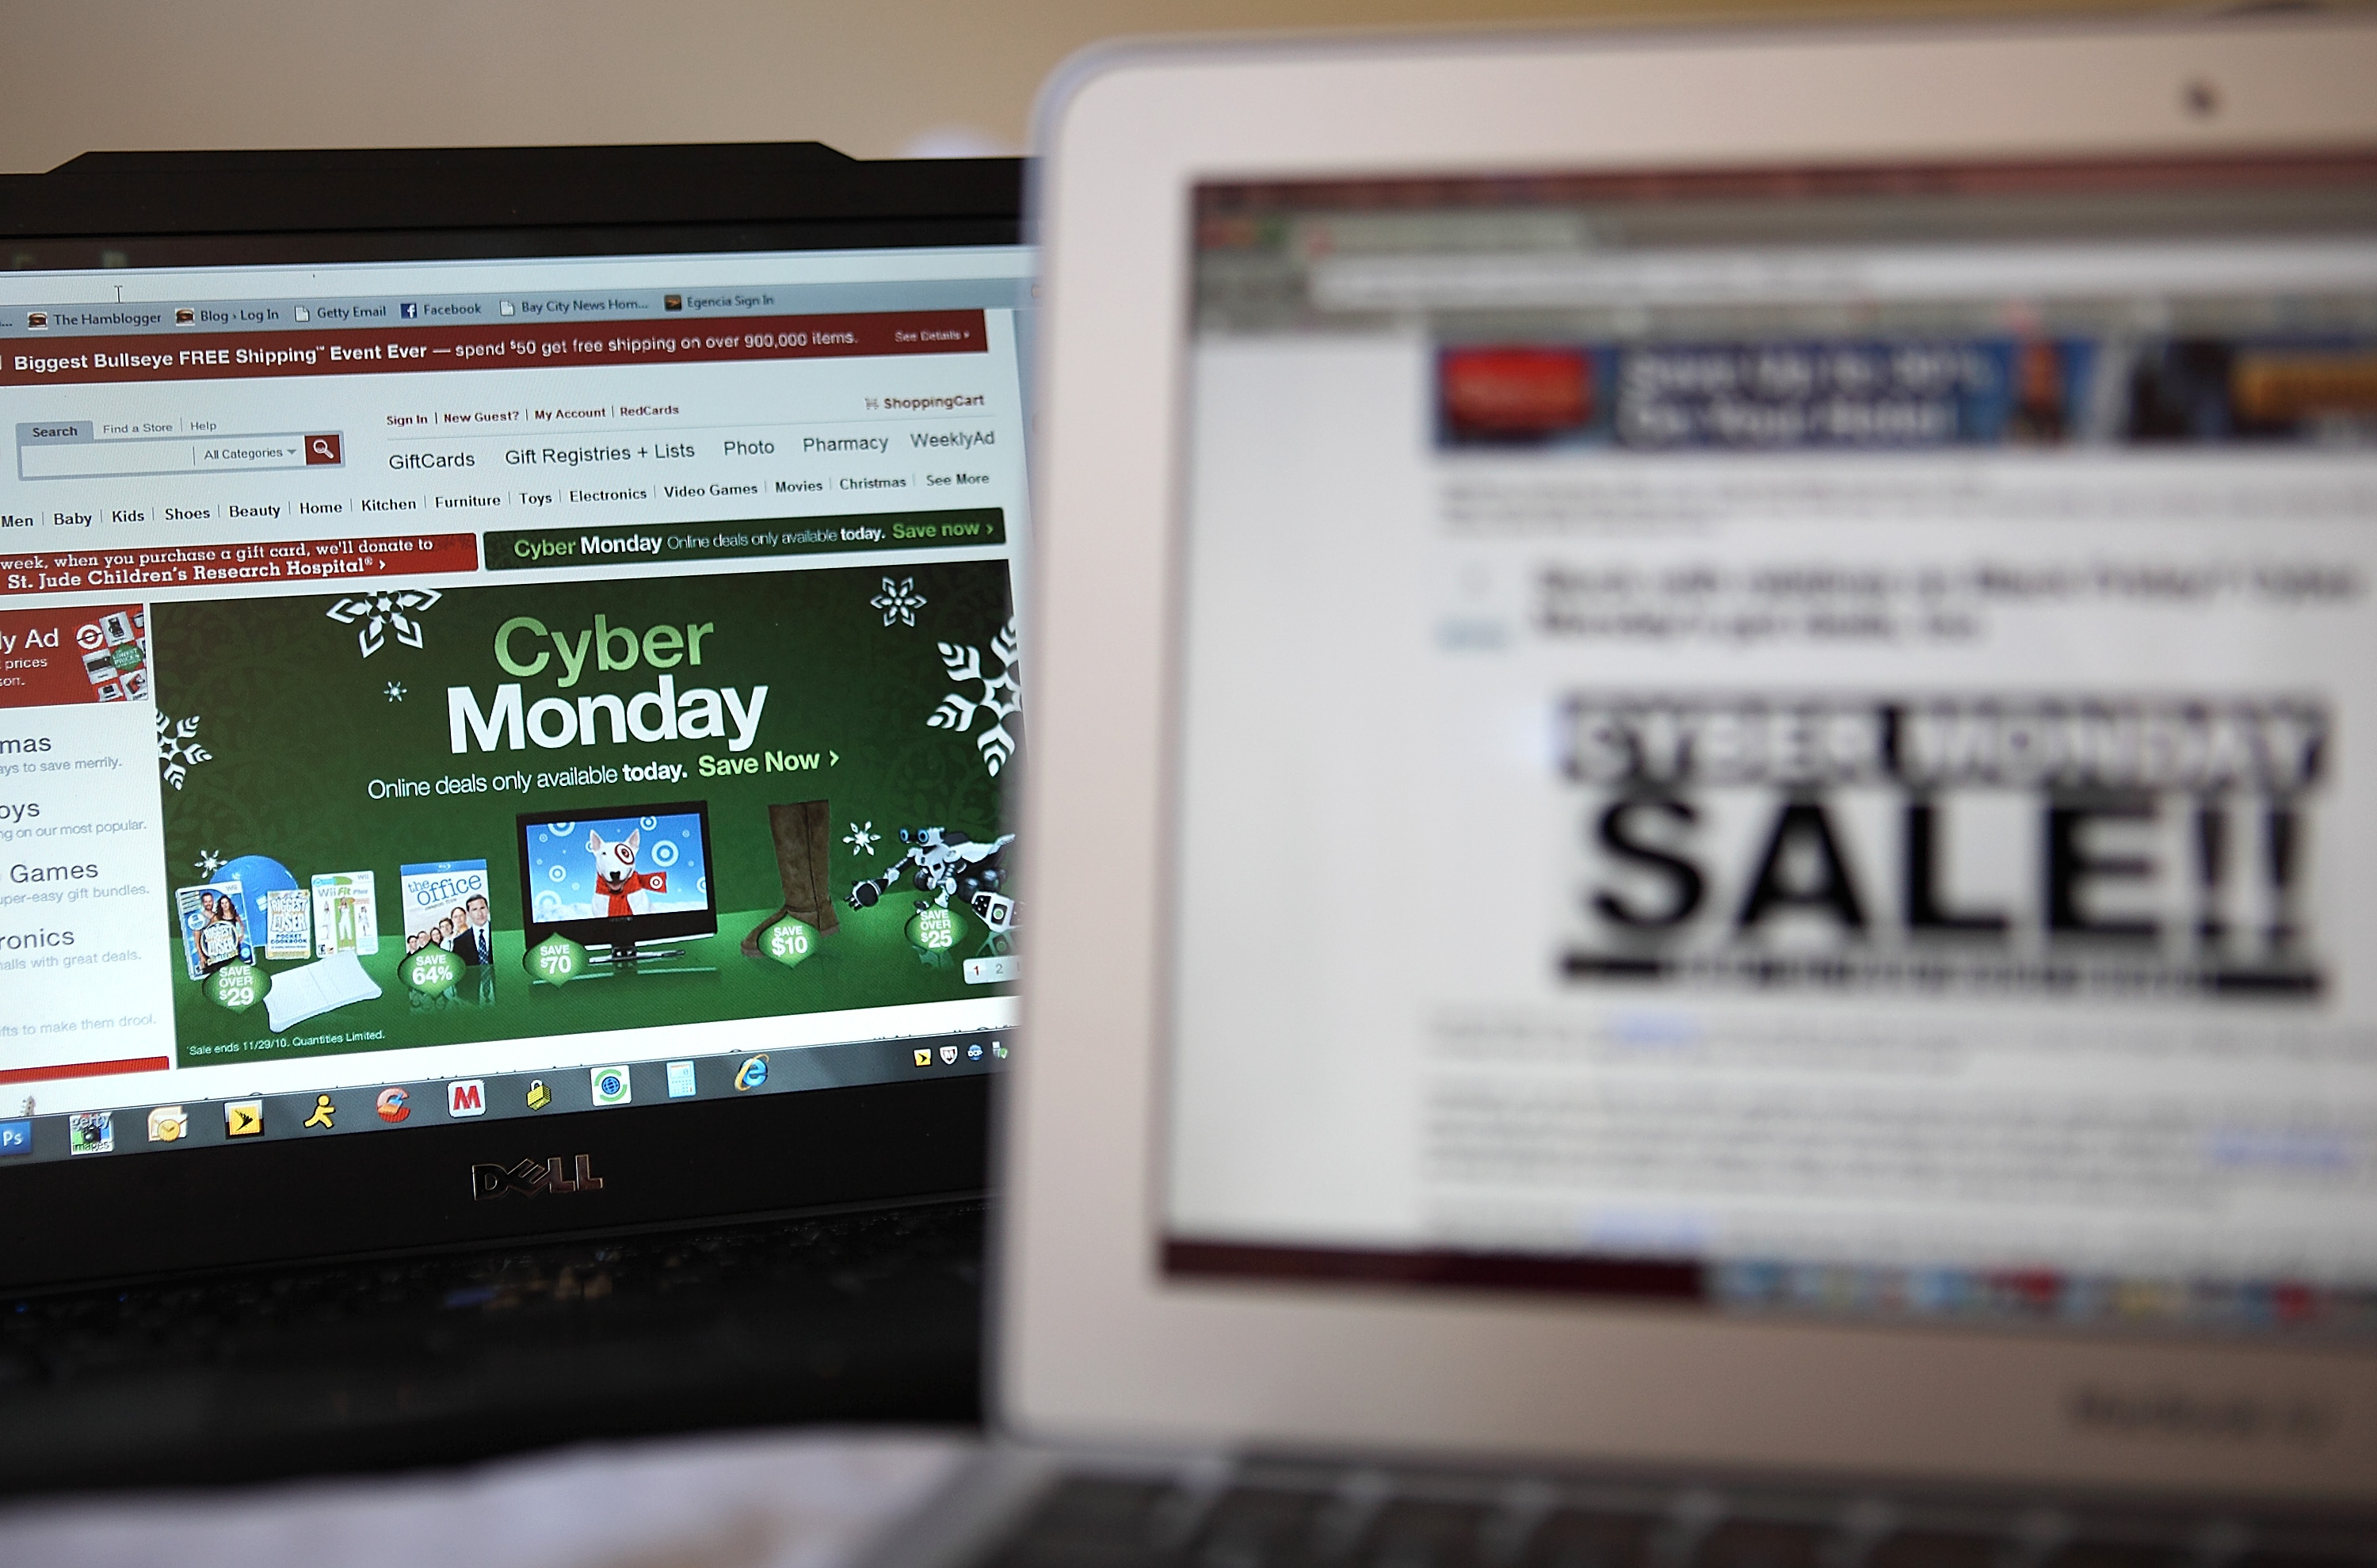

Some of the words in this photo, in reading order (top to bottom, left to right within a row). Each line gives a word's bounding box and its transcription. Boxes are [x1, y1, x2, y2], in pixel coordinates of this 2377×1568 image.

[423, 303, 482, 315] Facebook
[521, 301, 543, 314] Bay
[546, 299, 570, 313] City
[574, 299, 605, 311] News
[687, 296, 732, 310] Egencia
[735, 294, 758, 309] Sign
[760, 294, 774, 306] In
[53, 313, 78, 326] The
[82, 311, 161, 327] Hamblogger
[200, 310, 229, 324] Blog
[240, 308, 264, 322] Log
[267, 307, 279, 319] In
[317, 307, 349, 321] Getty
[353, 305, 387, 318] Email
[895, 330, 918, 343] See
[14, 355, 88, 373] Biggest
[93, 353, 173, 369] Bullseye
[179, 349, 230, 365] FREE
[330, 345, 382, 361] Event
[387, 343, 428, 360] Ever
[455, 341, 505, 360] spend
[509, 339, 536, 356] $50
[542, 339, 567, 357] get
[572, 338, 603, 353] free
[608, 336, 677, 354] shipping
[681, 337, 701, 350] on
[705, 335, 740, 349] over
[744, 333, 808, 349] 900,000
[811, 330, 859, 346] items.
[883, 395, 985, 411] ShoppingCart
[387, 414, 413, 428] Sign
[416, 414, 429, 425] In
[444, 412, 471, 424] New
[475, 410, 519, 423] Guest?
[534, 410, 552, 422] My
[555, 407, 606, 420] Account
[620, 405, 680, 418] RedCards
[32, 425, 78, 438] Search
[103, 424, 128, 434] Find
[143, 422, 173, 433] Store
[191, 421, 217, 433] Help
[723, 440, 775, 456] Photo
[803, 435, 889, 454] Pharmacy
[910, 430, 996, 451] WeeklyAd
[204, 449, 219, 461] All
[222, 448, 283, 462] Categories
[389, 452, 475, 470] GiftCards
[505, 448, 537, 466] Gift
[543, 445, 631, 467] Registries
[655, 441, 696, 460] Lists
[775, 480, 822, 494] Movies
[839, 477, 906, 491] Christmas
[926, 474, 952, 487] See
[955, 473, 990, 485] More
[570, 488, 647, 504] Electronics
[664, 484, 705, 498] Video
[709, 483, 758, 498] Games
[361, 498, 417, 513] Kitchen
[435, 494, 501, 509] Furniture
[519, 492, 552, 507] Toys
[112, 509, 145, 523] Kids
[165, 507, 211, 521] Shoes
[229, 504, 280, 520] Beauty
[300, 502, 342, 515] Home
[1, 514, 34, 528] Men
[54, 512, 92, 528] Baby
[514, 539, 577, 560] Cyber
[580, 533, 663, 555] Monday
[667, 534, 710, 550] Online
[712, 532, 749, 547] deals
[751, 531, 778, 548] only
[781, 527, 837, 544] available
[840, 525, 886, 544] today.
[892, 522, 937, 540] Save
[940, 521, 981, 537] now
[1, 557, 48, 571] week,
[55, 554, 99, 568] when
[104, 554, 135, 569] you
[139, 548, 216, 567] purchase
[220, 548, 231, 560] a
[236, 545, 265, 563] gift
[269, 543, 311, 558] card,
[315, 540, 353, 556] we'll
[358, 538, 414, 555] donate
[418, 539, 433, 551] to
[7, 573, 34, 589] St.
[39, 570, 82, 589] Jude
[87, 566, 187, 586] Children's
[193, 562, 280, 581] Research
[25, 628, 59, 650] Ad
[494, 613, 714, 688] Cyber
[5, 657, 48, 672] prices
[446, 673, 769, 755] Monday
[23, 762, 36, 773] to
[40, 760, 71, 772] save
[75, 757, 122, 770] merrily.
[368, 776, 431, 800] Online
[435, 773, 488, 795] deals
[491, 771, 532, 793] only
[536, 765, 618, 789] available
[622, 761, 689, 784] today.
[698, 753, 758, 778] Save
[764, 750, 820, 773] Now
[16, 829, 32, 838] on
[35, 826, 57, 837] our
[60, 822, 93, 835] most
[96, 819, 147, 836] popular.
[10, 864, 99, 884] Games
[1591, 795, 2304, 943] SALE!!
[67, 887, 89, 903] gift
[93, 883, 150, 898] bundles.
[318, 887, 337, 898] Wii
[338, 887, 351, 896] Fit
[407, 879, 430, 893] the
[417, 874, 483, 906] office
[920, 909, 949, 921] SAVE
[773, 925, 803, 937] SAVE
[920, 919, 952, 931] OVER
[771, 935, 808, 957] $10
[921, 929, 953, 948] $25
[30, 956, 59, 968] with
[63, 952, 98, 968] great
[101, 949, 142, 963] deals.
[540, 944, 570, 957] SAVE
[416, 954, 446, 966] SAVE
[540, 955, 572, 975] $70
[219, 966, 252, 978] SAVE
[412, 965, 453, 986] 64%
[973, 965, 979, 976] 1
[219, 976, 253, 988] OVER
[219, 987, 254, 1007] $29
[22, 1024, 36, 1036] to
[40, 1021, 78, 1034] make
[81, 1018, 115, 1030] them
[119, 1013, 158, 1028] drool.
[214, 1043, 240, 1054] ends
[292, 1033, 344, 1047] Quantities
[345, 1029, 386, 1043] Limited.
[71, 1112, 113, 1131] getty
[2, 1131, 23, 1146] Ps
[71, 1139, 111, 1153] images
[471, 1154, 604, 1200] DELL
